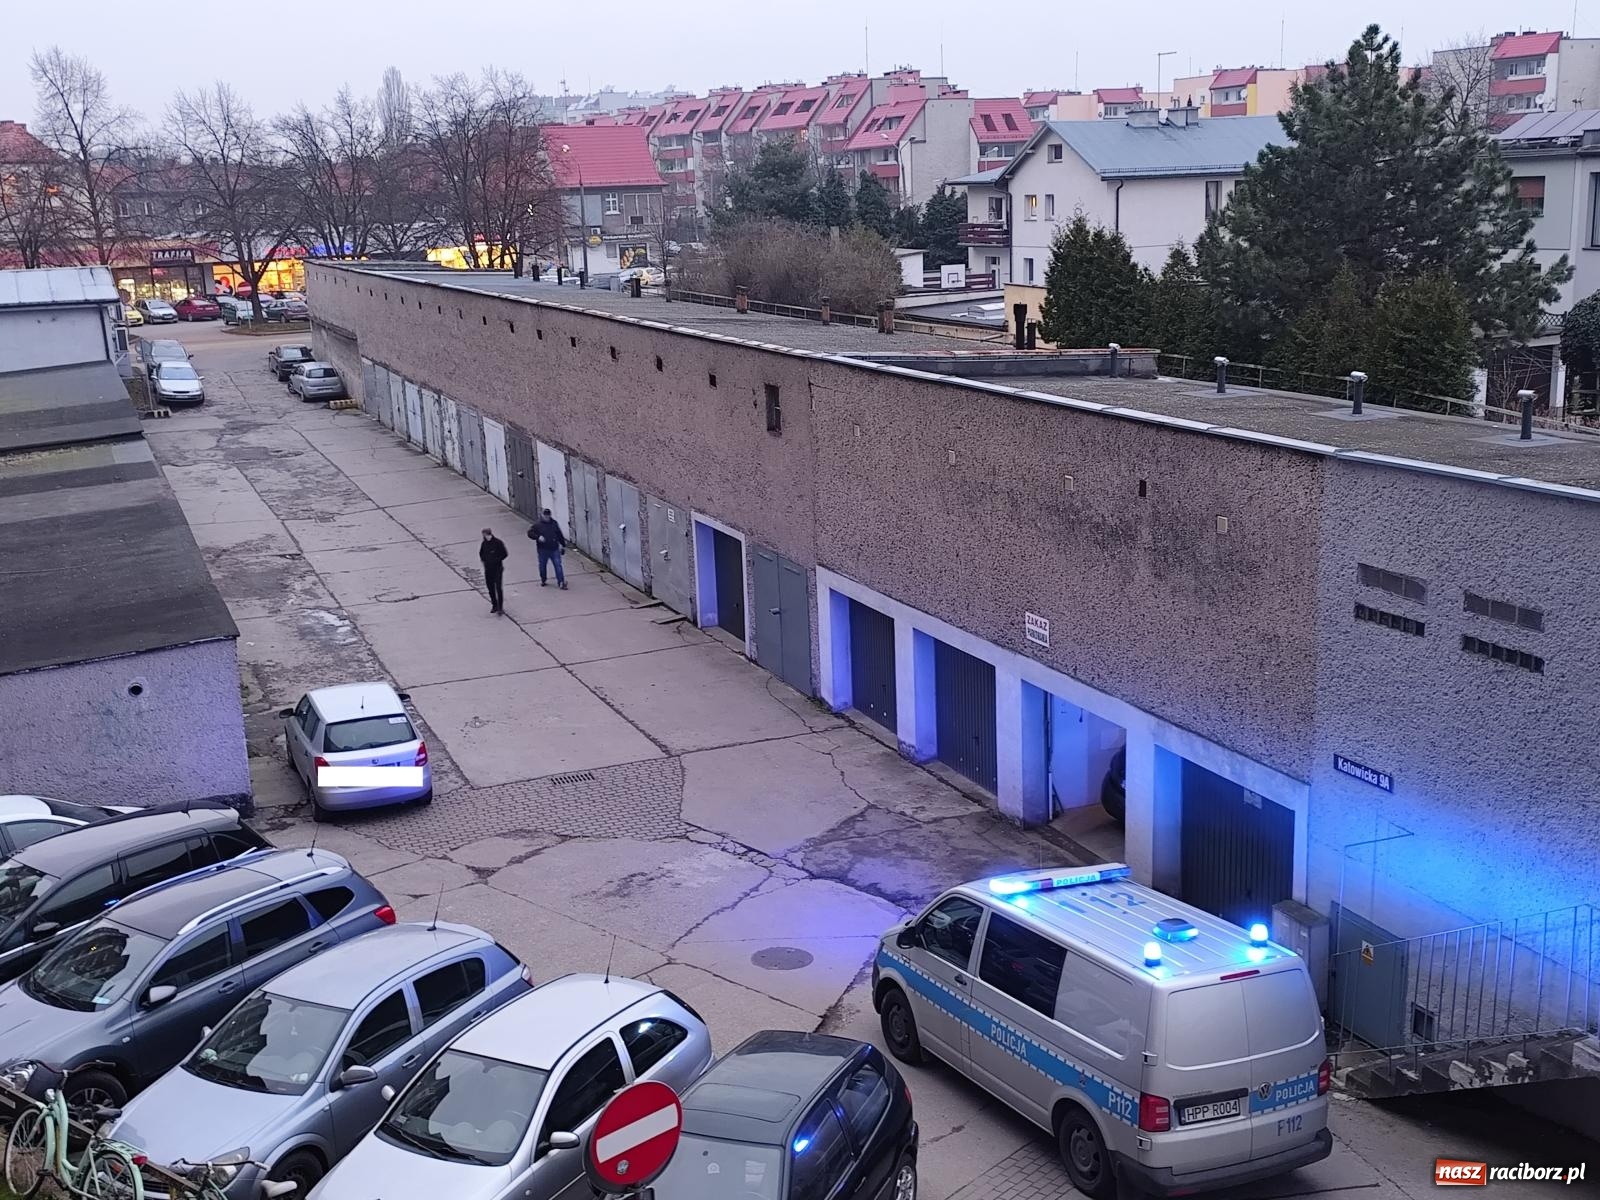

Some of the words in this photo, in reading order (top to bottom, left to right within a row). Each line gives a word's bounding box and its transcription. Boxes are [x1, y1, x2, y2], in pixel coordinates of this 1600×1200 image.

[151, 250, 192, 260] TRAFIKA
[1337, 756, 1378, 785] Katowicka
[1379, 774, 1390, 790] 9A
[1056, 874, 1096, 886] POLICJA
[991, 1023, 1027, 1058] POLICJA
[1275, 1080, 1315, 1102] POLICJA
[1186, 1105, 1210, 1121] HPP
[1212, 1100, 1238, 1116] R004
